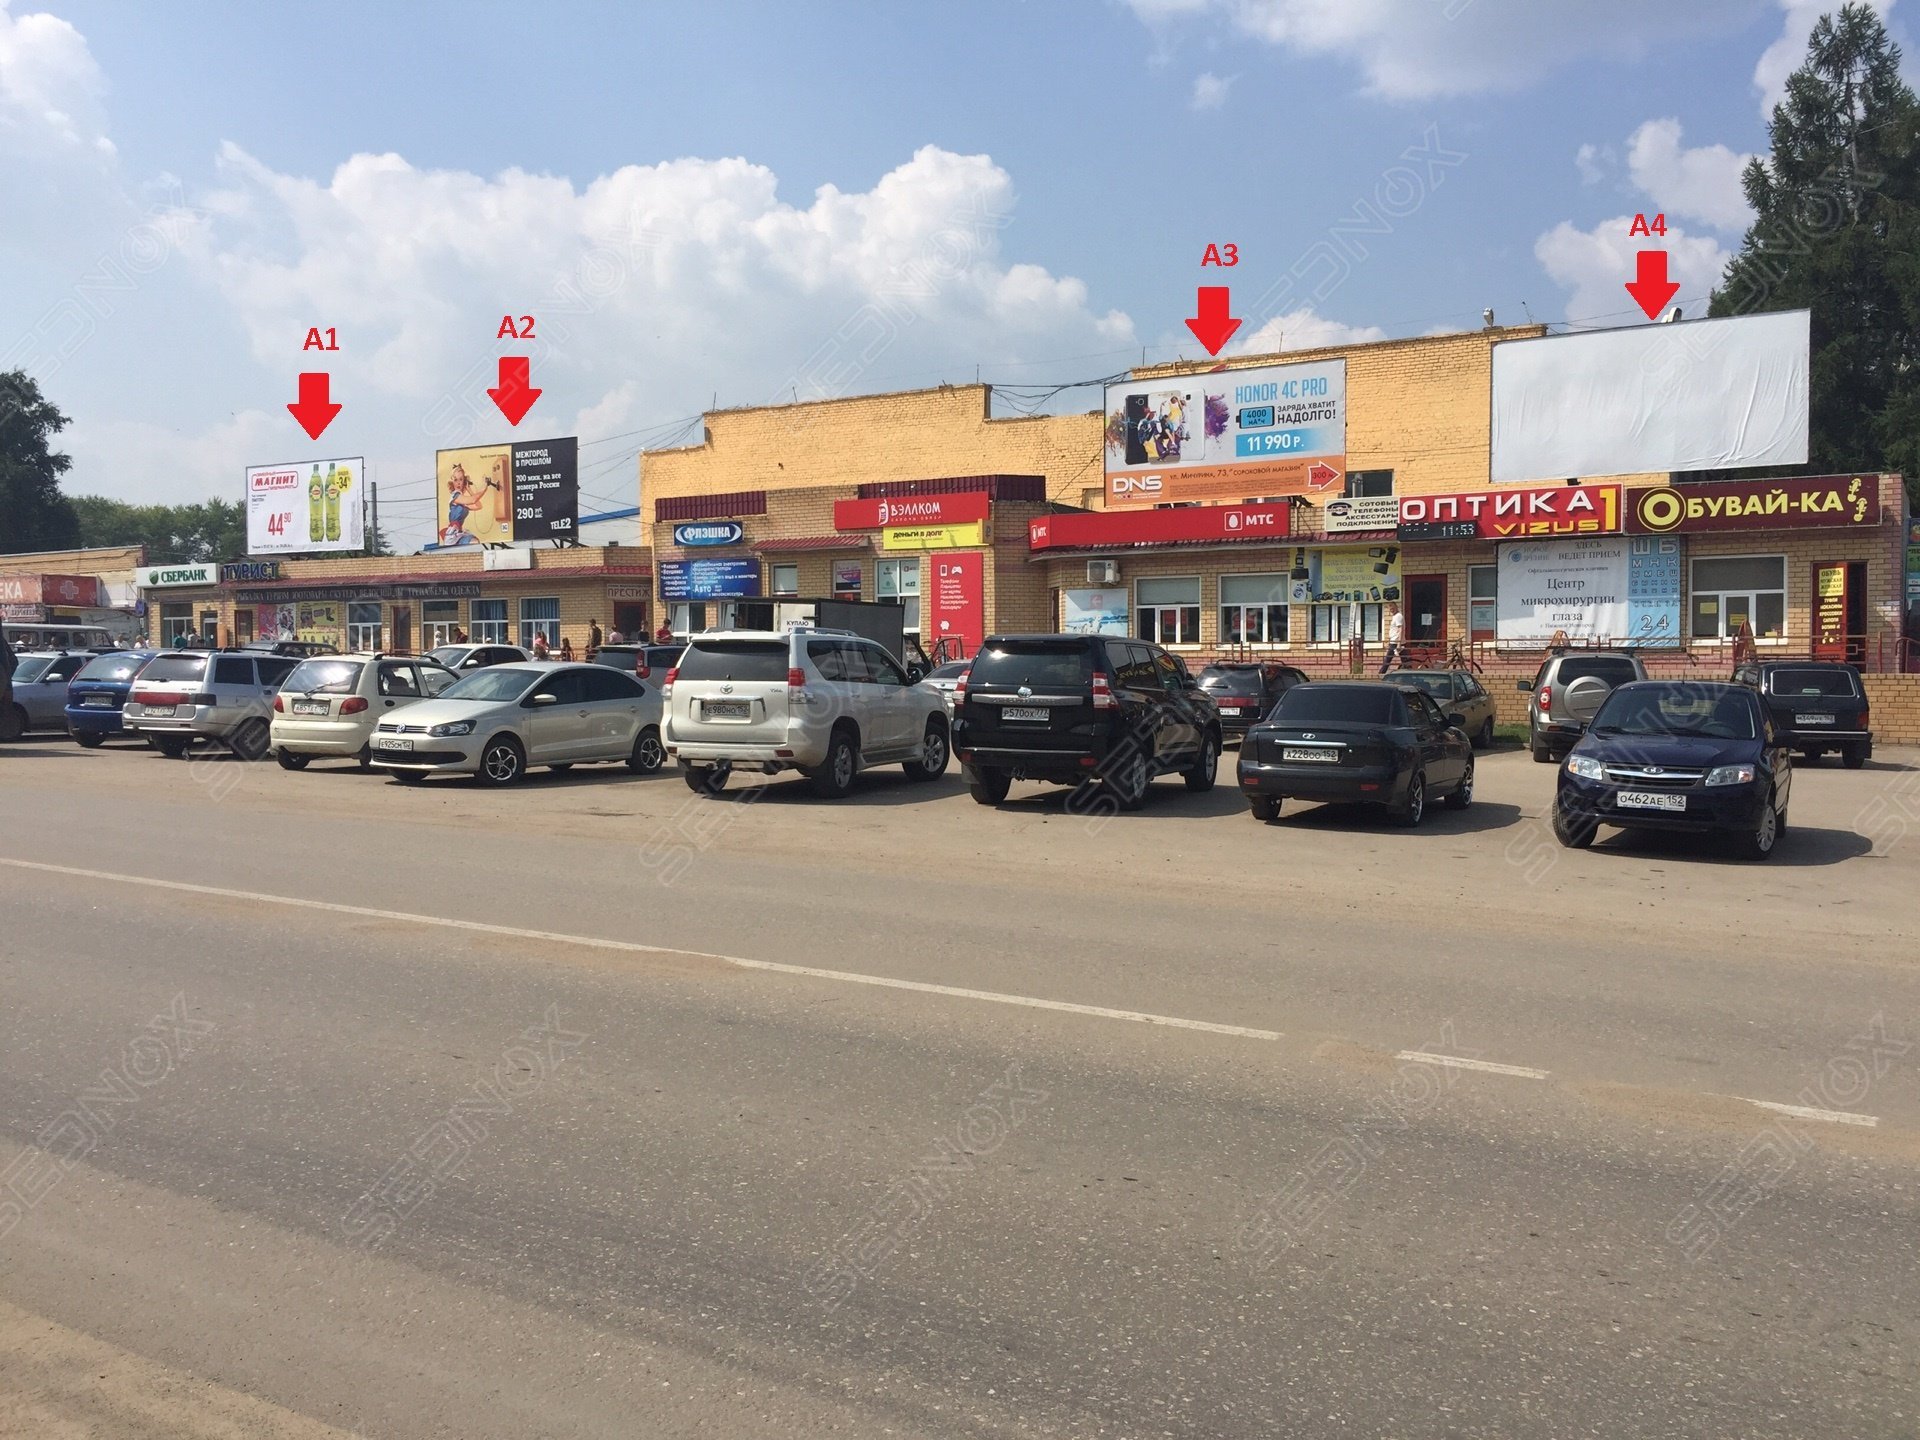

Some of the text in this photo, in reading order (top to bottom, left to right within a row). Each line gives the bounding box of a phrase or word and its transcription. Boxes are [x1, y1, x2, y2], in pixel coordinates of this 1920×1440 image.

[1235, 377, 1327, 404] HONOR 4C PRO
[1277, 400, 1336, 413] ЗАРЯДА ХВАТИТ
[1246, 409, 1267, 418] 4000
[1277, 409, 1336, 425] НАДОЛГО!
[1247, 436, 1260, 451] 11
[1265, 434, 1291, 450] 990
[515, 449, 549, 459] МЕЖГОРОД
[520, 457, 552, 467] ПРОШЛОМ
[254, 475, 296, 486] МАГНИТ
[1112, 474, 1163, 492] DNS
[516, 508, 534, 519] 290
[890, 501, 941, 516] ВЭЛЛКОМ
[1402, 487, 1617, 531] ОПТИКА 1
[1640, 488, 1844, 533] ОБУВАЙ-КА
[268, 512, 284, 536] 44
[550, 517, 572, 530] TELE2
[1245, 513, 1274, 526] МТС
[1336, 519, 1399, 528] ПОДКЛЮЧЕНИЕ
[683, 526, 731, 541] ФЛЭШКА
[1037, 526, 1047, 538] МТС
[1493, 519, 1600, 537] VIZUS
[1574, 541, 1602, 549] ЗДЕСЬ
[1632, 538, 1678, 555] Ш Б
[1558, 551, 1621, 560] ВЕДЕТ ПРИЕМ
[161, 569, 208, 583] СБЕРБАНК
[223, 562, 278, 580] ТУРИСТ
[1546, 578, 1585, 591] Центр
[607, 587, 651, 597] ПРЕСТИЖ
[1521, 594, 1615, 608] микрохирургии
[1552, 612, 1583, 622] глаза
[1620, 794, 1684, 806] О462АЕ 152
